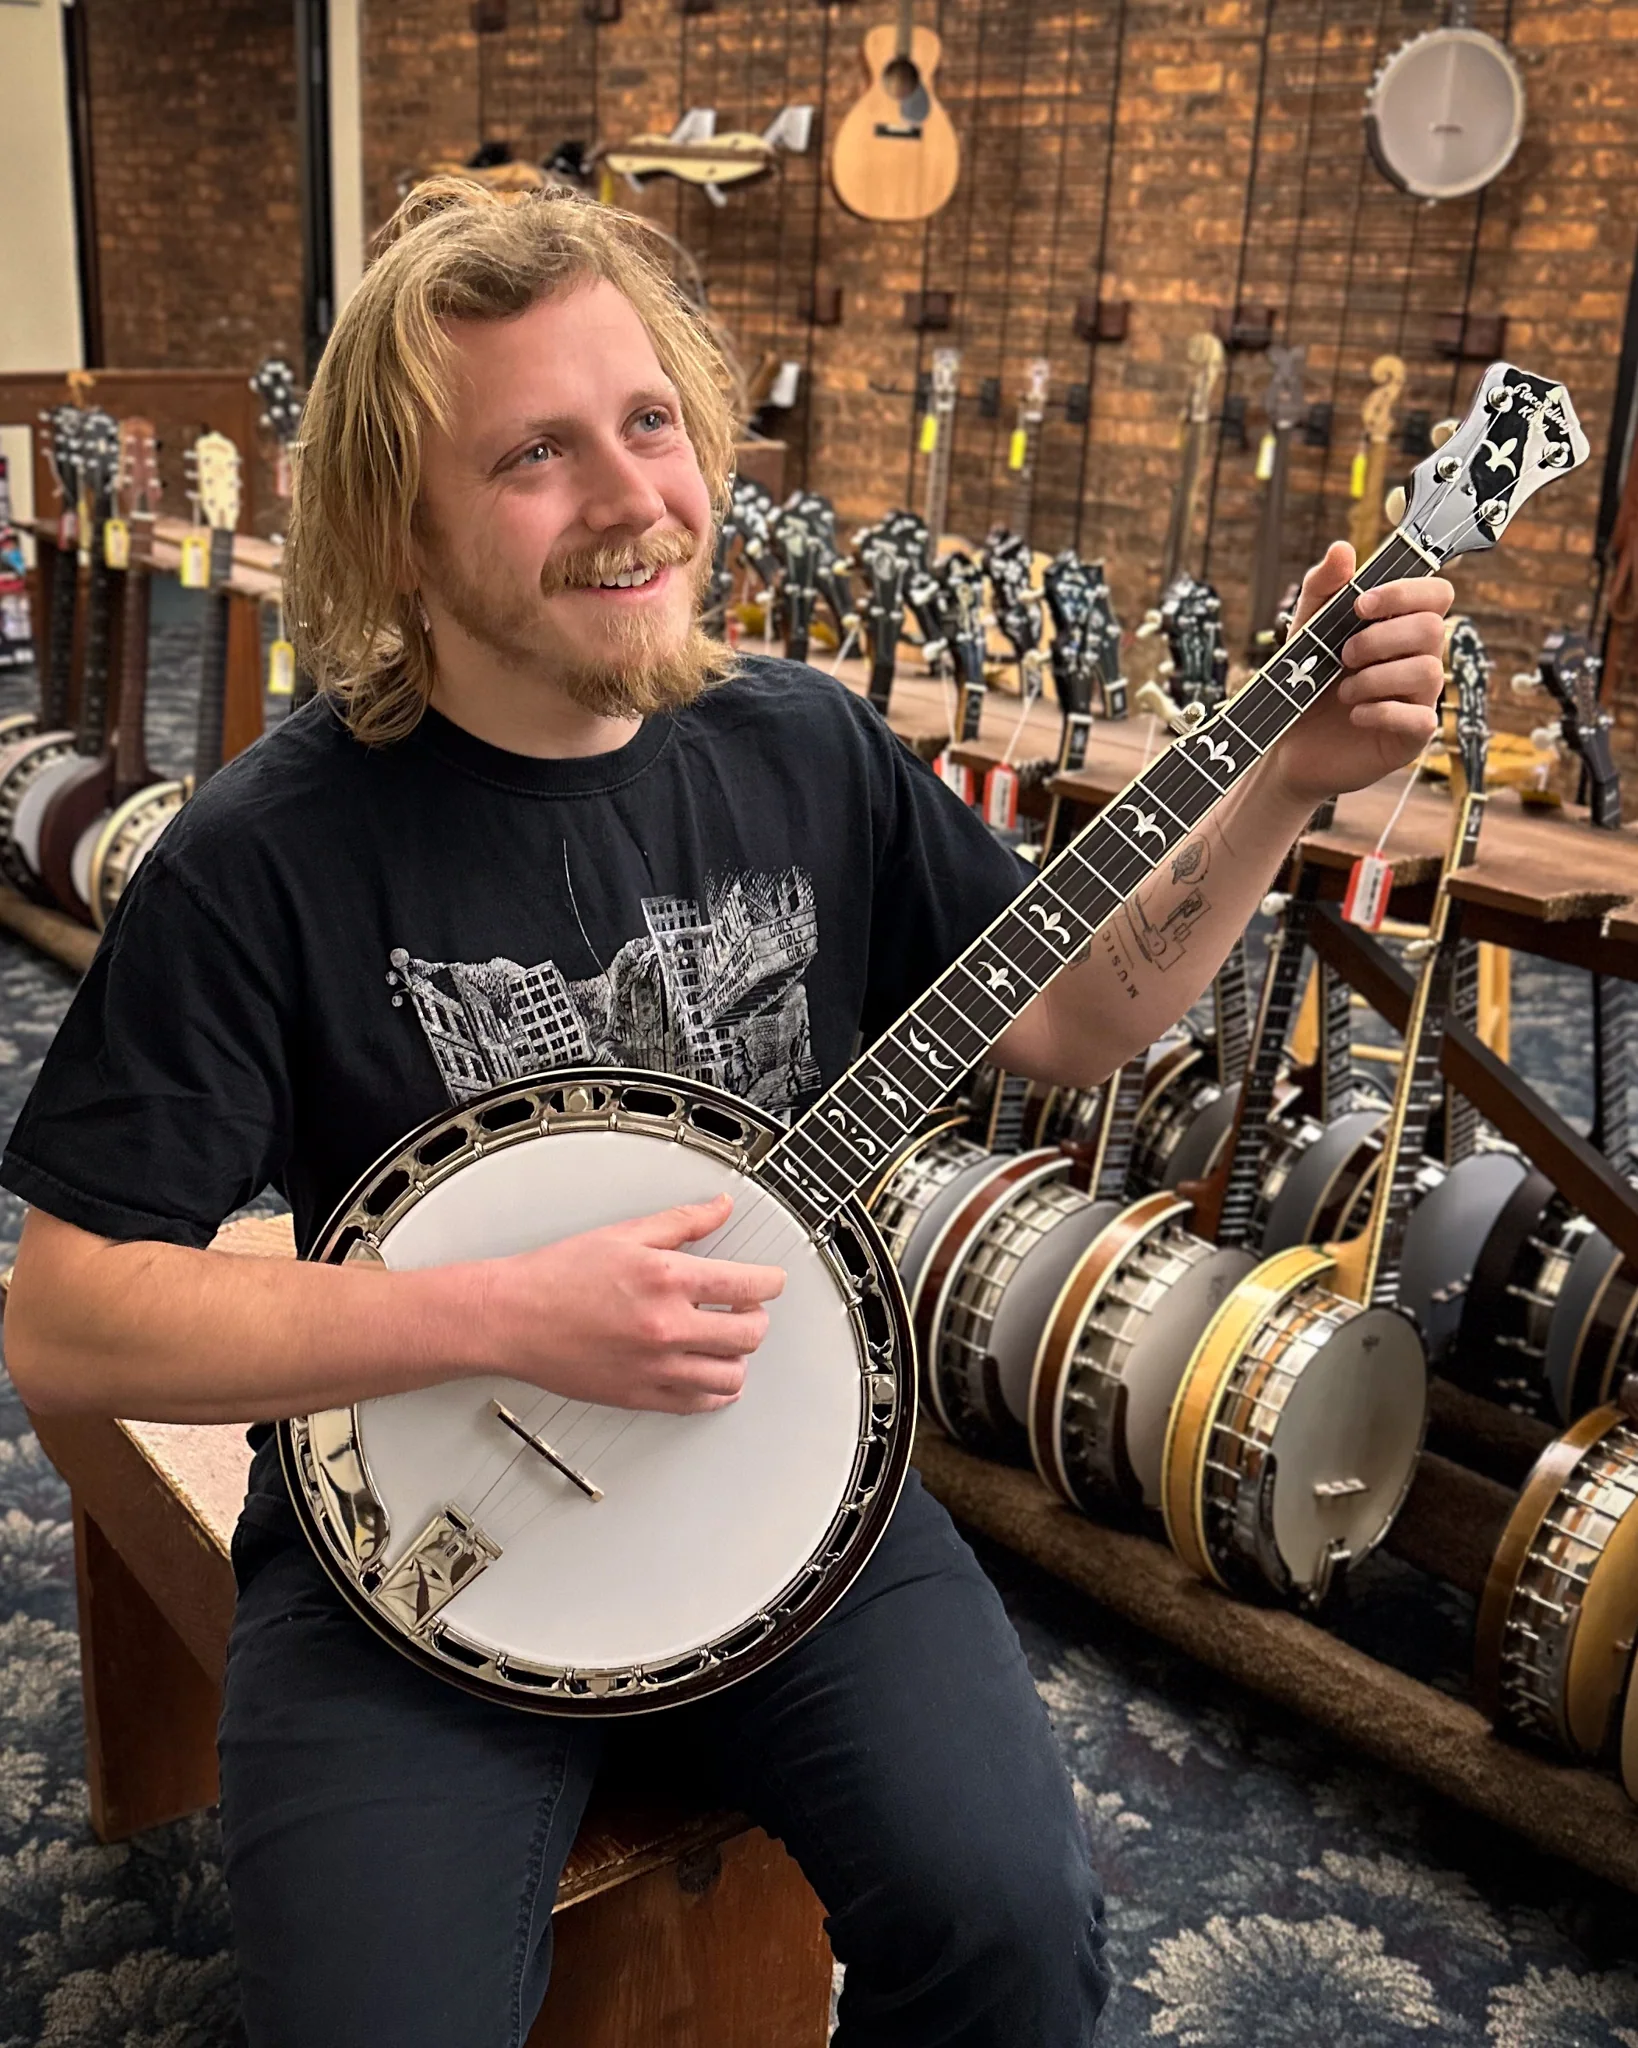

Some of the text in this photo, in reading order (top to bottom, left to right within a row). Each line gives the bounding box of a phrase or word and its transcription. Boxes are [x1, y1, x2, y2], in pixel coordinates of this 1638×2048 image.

[769, 919, 793, 938] GIRLS
[778, 930, 803, 951] GIRLS
[786, 942, 808, 961] GIRLS
[1102, 930, 1140, 999] MUSIC
